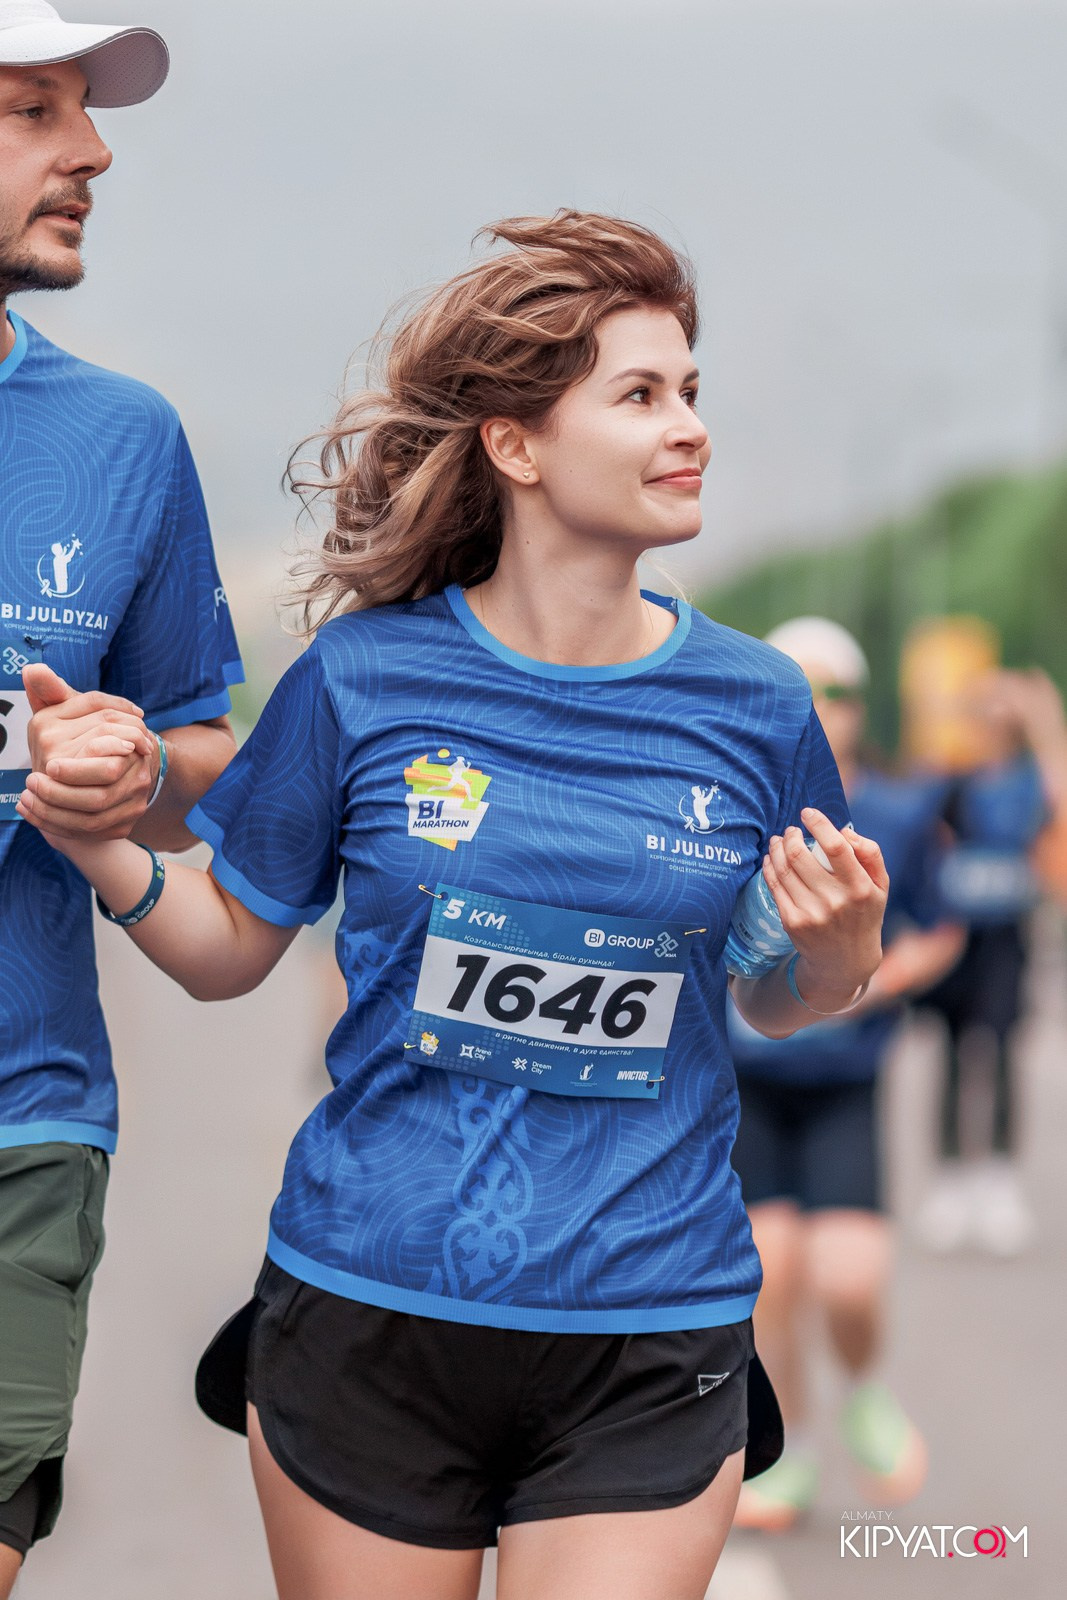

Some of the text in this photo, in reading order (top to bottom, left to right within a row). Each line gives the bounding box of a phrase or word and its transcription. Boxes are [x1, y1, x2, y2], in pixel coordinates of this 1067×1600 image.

[1, 603, 109, 630] BI JULDYZAI
[417, 800, 445, 819] BI
[413, 820, 470, 829] MARATHON
[646, 834, 742, 866] BI JULDYZAI
[442, 898, 466, 920] 5
[607, 934, 655, 949] GROUP
[447, 954, 658, 1039] 1646
[501, 1034, 528, 1045] ритме
[528, 1040, 571, 1053] движения,
[580, 1048, 598, 1056] духе
[474, 1053, 486, 1061] City
[532, 1061, 552, 1070] Dream
[531, 1067, 544, 1075] City
[616, 1070, 650, 1080] INVICTUS
